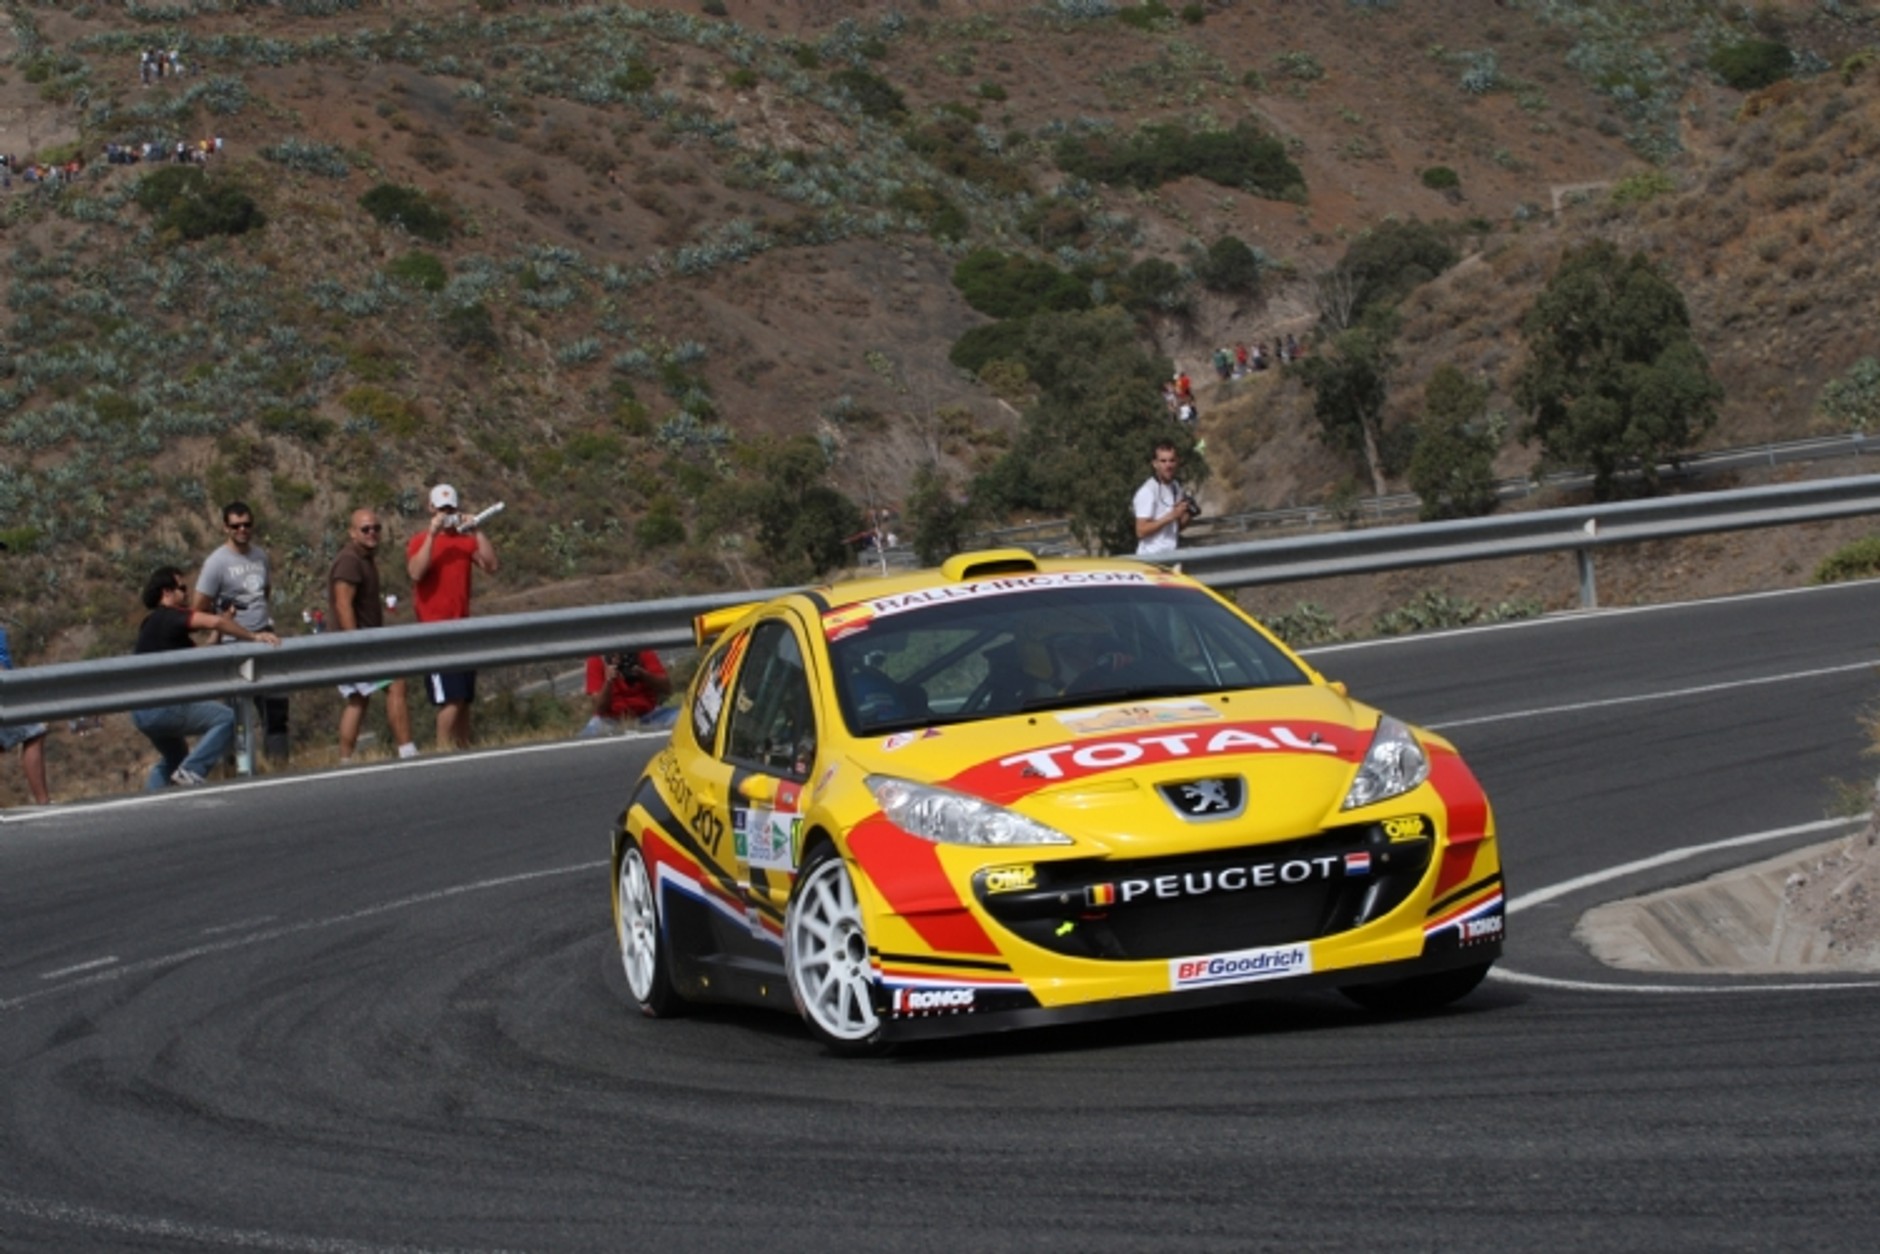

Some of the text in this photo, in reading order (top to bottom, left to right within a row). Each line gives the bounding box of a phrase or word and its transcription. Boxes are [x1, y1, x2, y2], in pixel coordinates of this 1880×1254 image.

[874, 572, 1144, 612] RALLY-IRC.COM
[999, 727, 1337, 778] TOTAL
[1120, 856, 1338, 902] PEUGEOT
[1177, 950, 1303, 980] BFGoodrich
